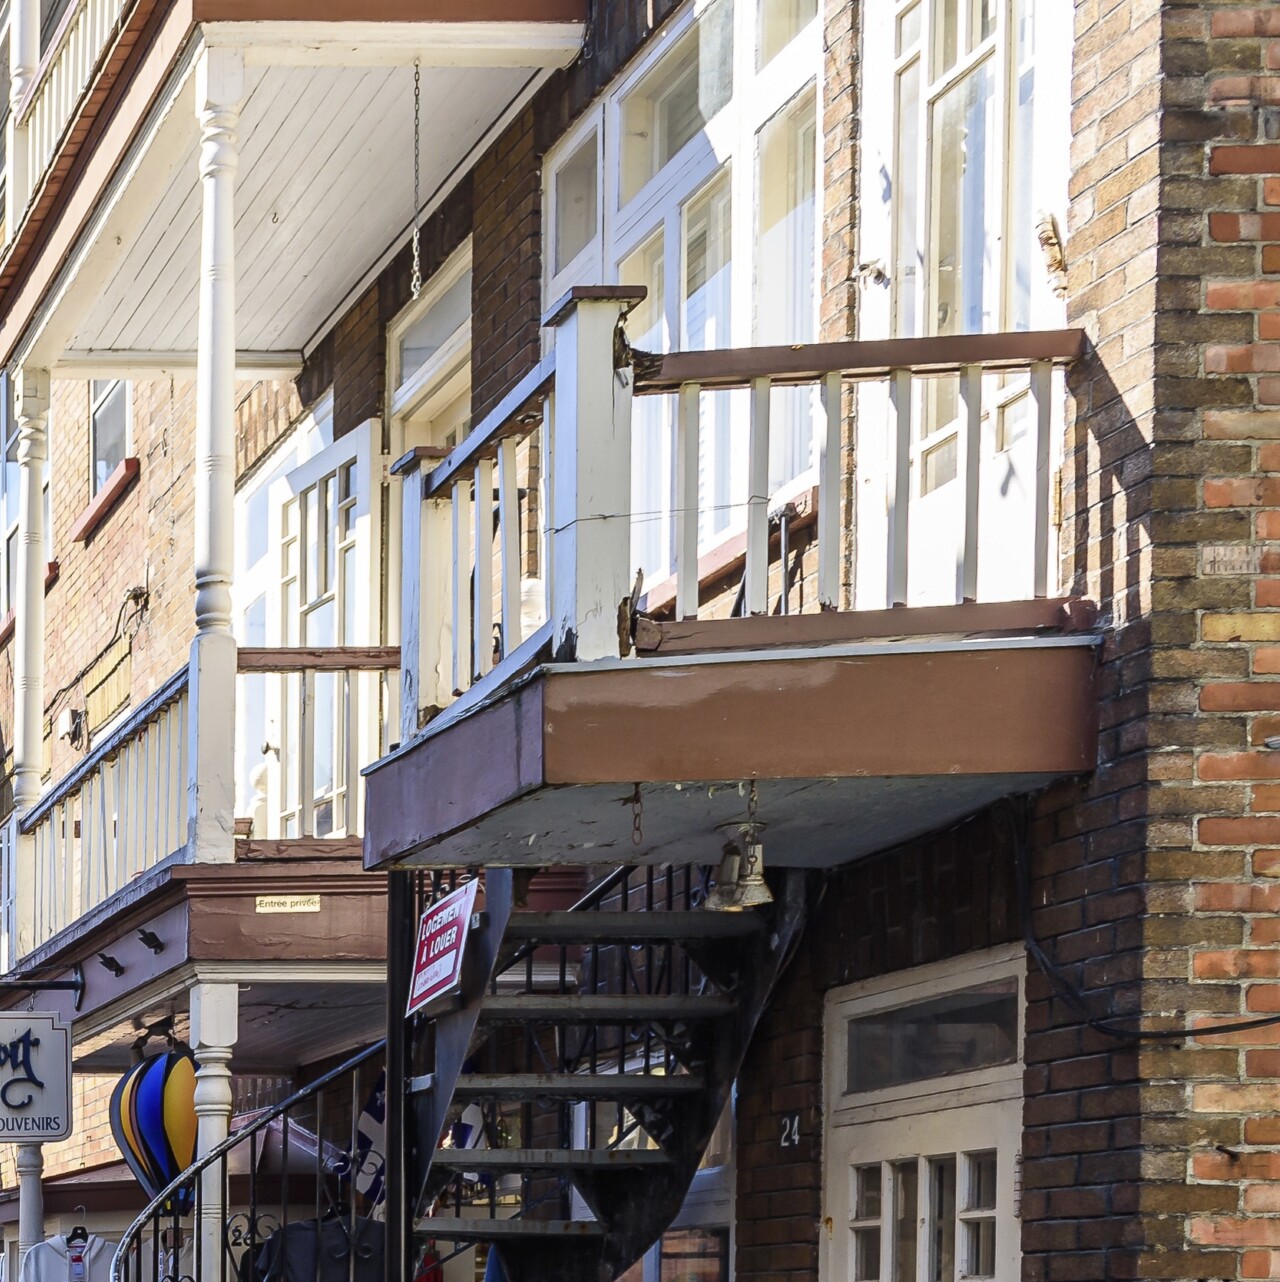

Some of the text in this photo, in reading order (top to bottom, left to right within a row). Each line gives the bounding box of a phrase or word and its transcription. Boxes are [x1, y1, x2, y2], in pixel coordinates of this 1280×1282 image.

[258, 898, 317, 909] Entrée privée
[429, 925, 458, 958] LOUER
[780, 1114, 800, 1148] 24
